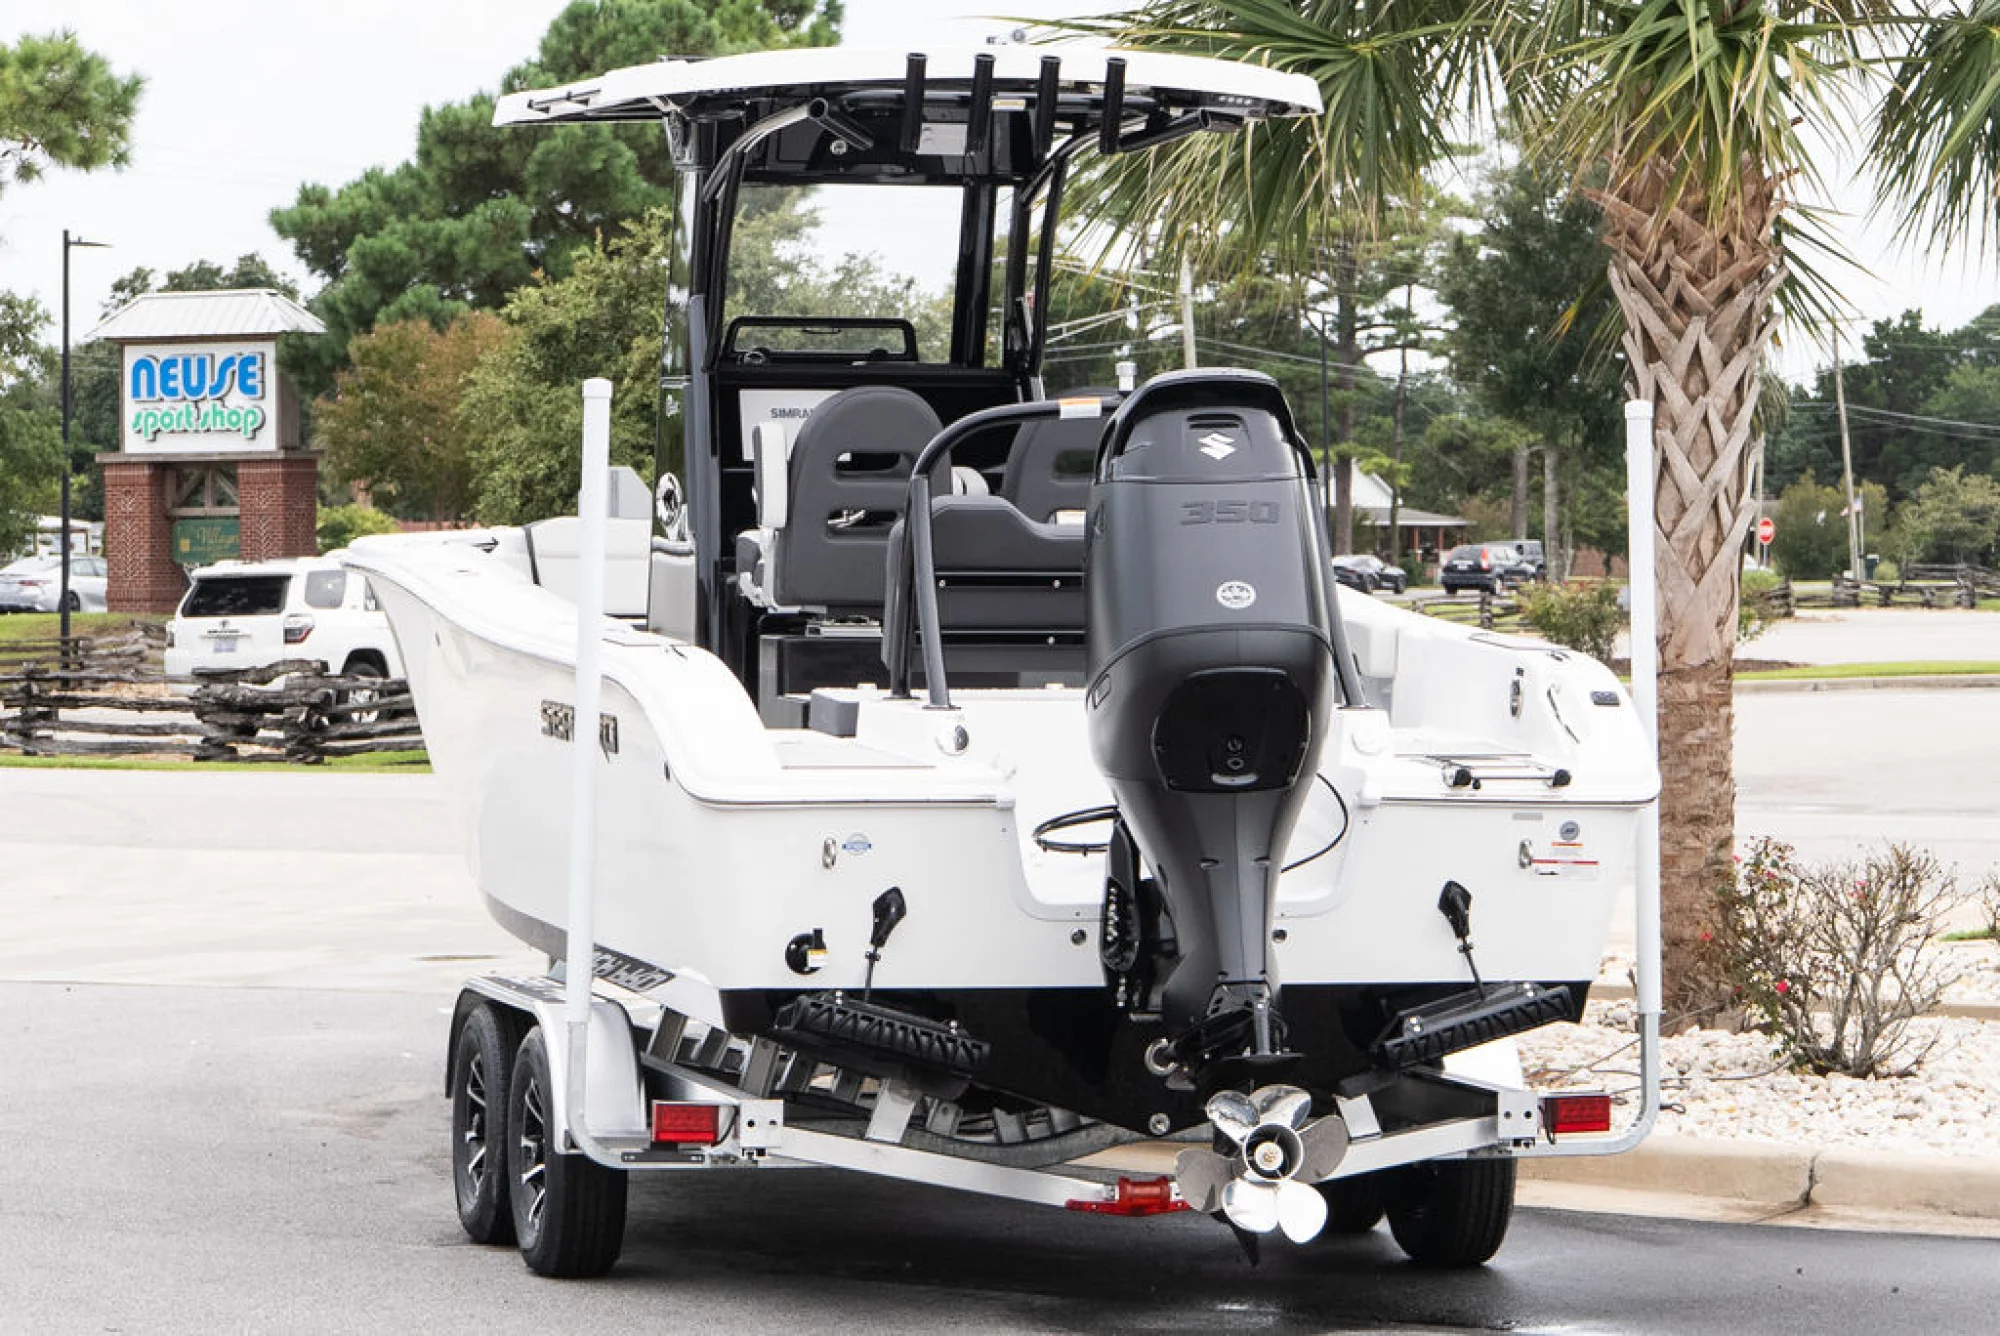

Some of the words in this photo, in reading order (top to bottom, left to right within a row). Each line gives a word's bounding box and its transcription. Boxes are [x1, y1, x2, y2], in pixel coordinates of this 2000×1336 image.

[131, 354, 260, 399] NEUSE
[132, 402, 195, 438] sport
[200, 401, 259, 437] shop
[1180, 501, 1280, 526] 350
